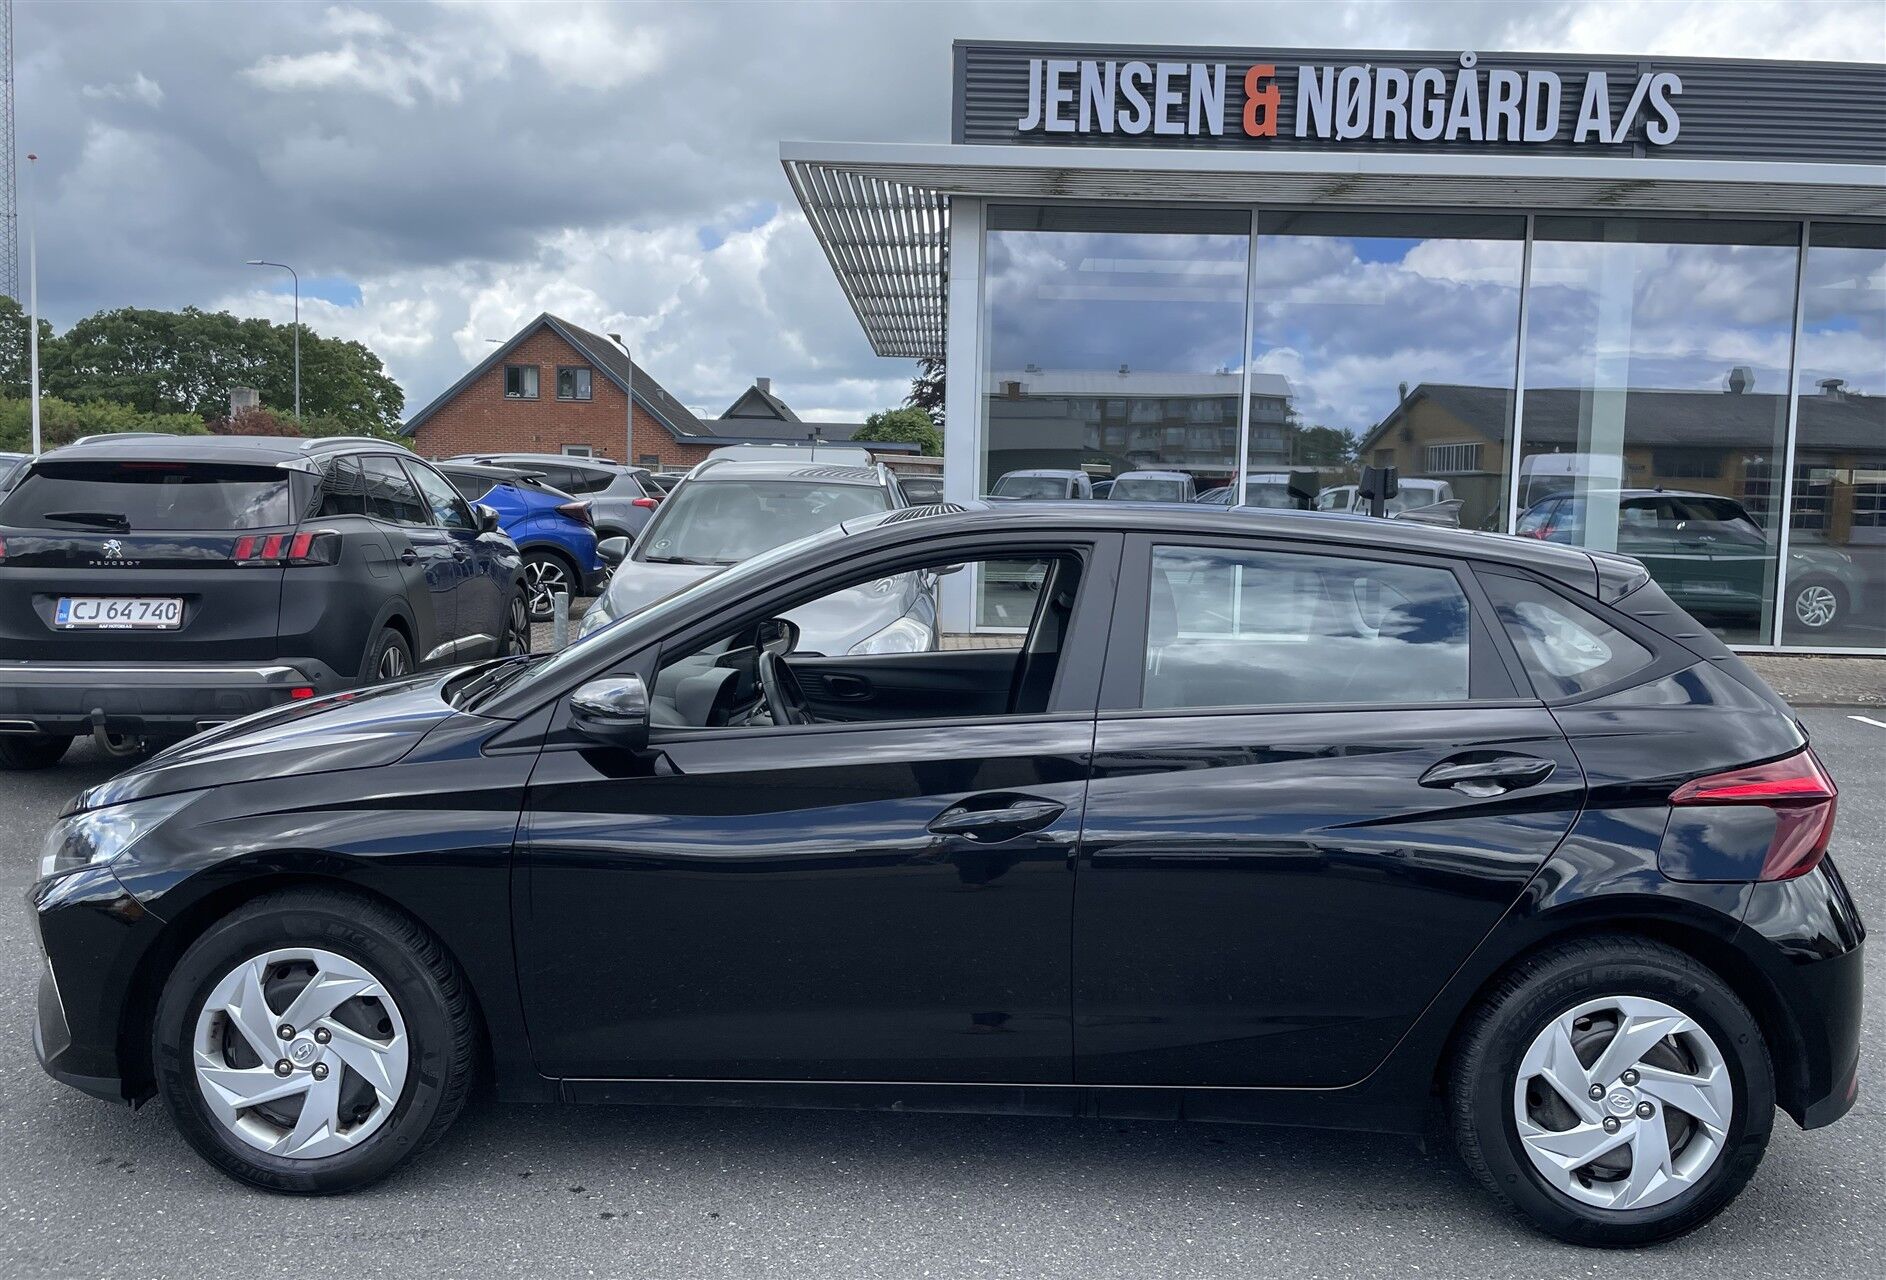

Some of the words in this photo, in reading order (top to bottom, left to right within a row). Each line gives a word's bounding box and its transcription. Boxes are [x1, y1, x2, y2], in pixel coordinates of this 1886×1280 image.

[1018, 59, 1227, 136] JENSEN
[1242, 63, 1281, 138] &
[1295, 50, 1562, 142] NØRGÅRD
[1573, 71, 1683, 146] A/S
[73, 602, 101, 620] CJ
[106, 601, 133, 620] 64
[138, 602, 178, 620] 740
